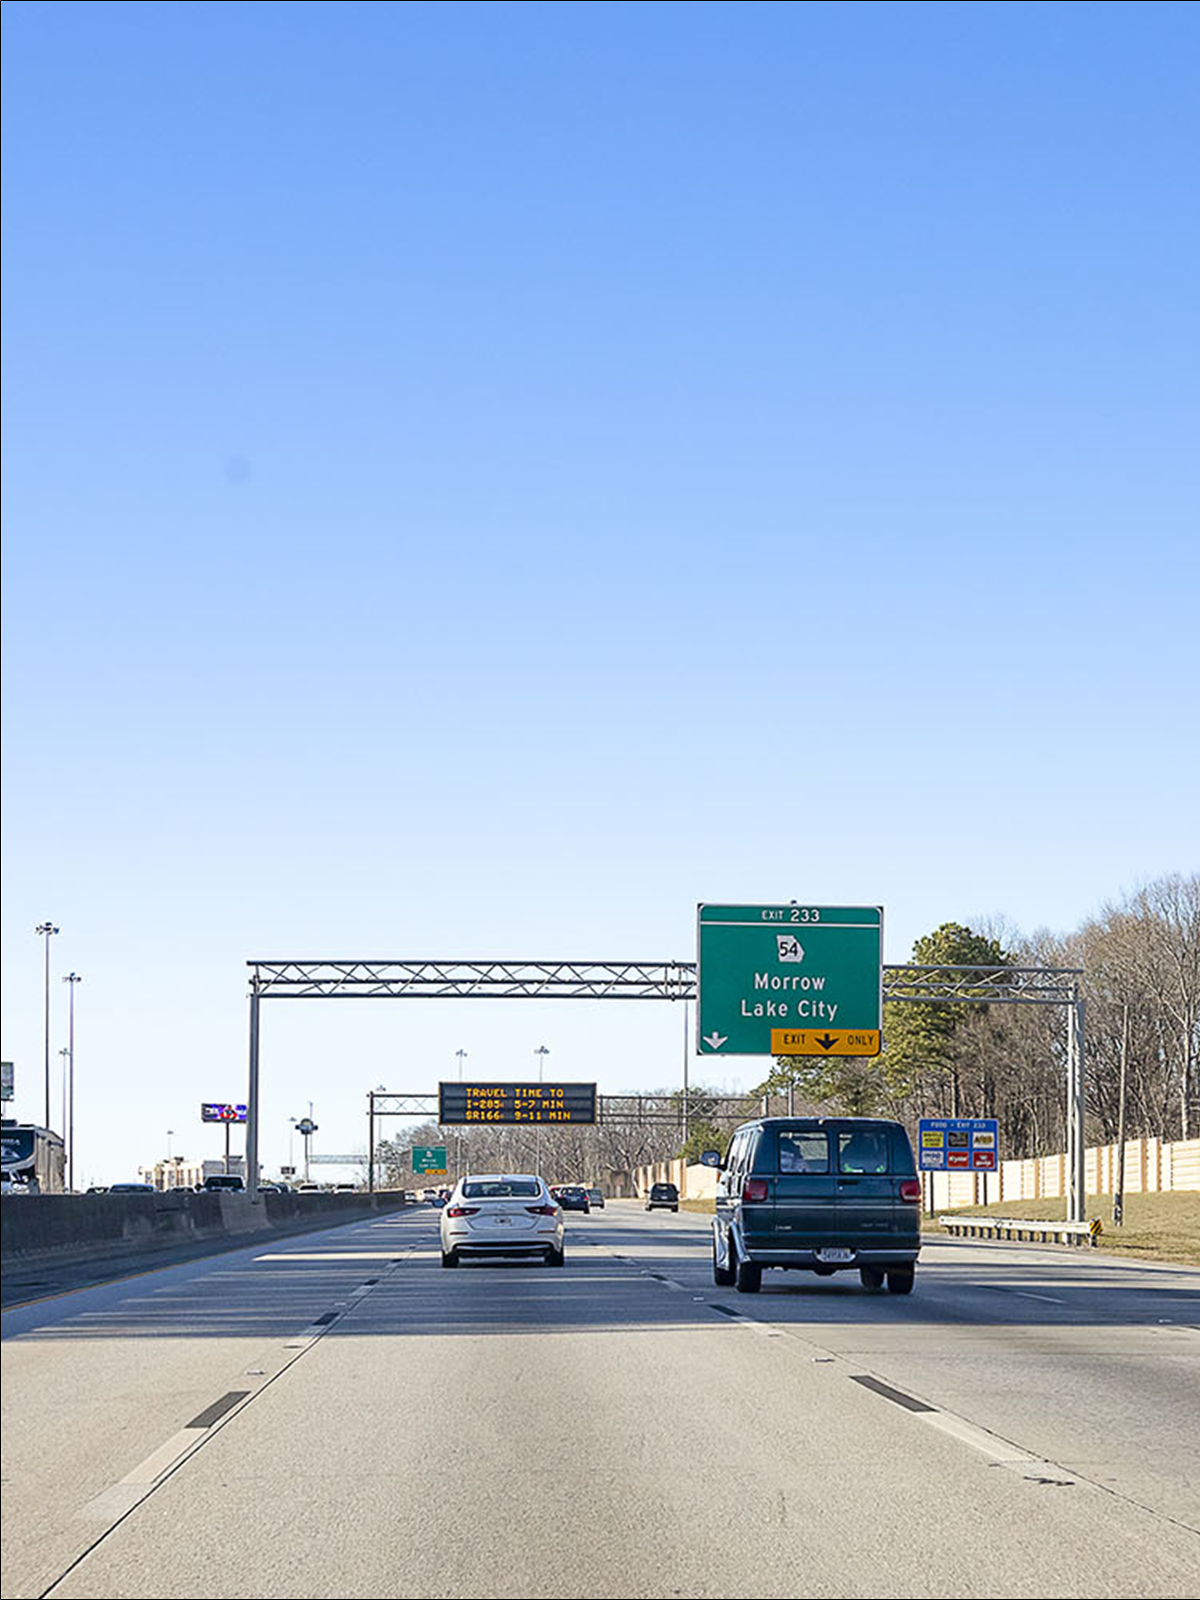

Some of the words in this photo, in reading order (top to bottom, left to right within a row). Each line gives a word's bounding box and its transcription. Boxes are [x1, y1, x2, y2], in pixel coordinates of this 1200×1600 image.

[761, 909, 784, 920] EXIT
[790, 908, 820, 922] 233
[779, 942, 799, 957] 54
[754, 972, 826, 990] Morrow
[741, 999, 788, 1017] Lake
[798, 1000, 838, 1022] City
[783, 1034, 806, 1045] EXIT
[847, 1035, 874, 1046] ONLY
[465, 1088, 507, 1098] TRAVEL
[514, 1088, 542, 1098] TIME
[549, 1088, 564, 1098] TO
[542, 1100, 564, 1109] MIN
[549, 1111, 571, 1121] MIN
